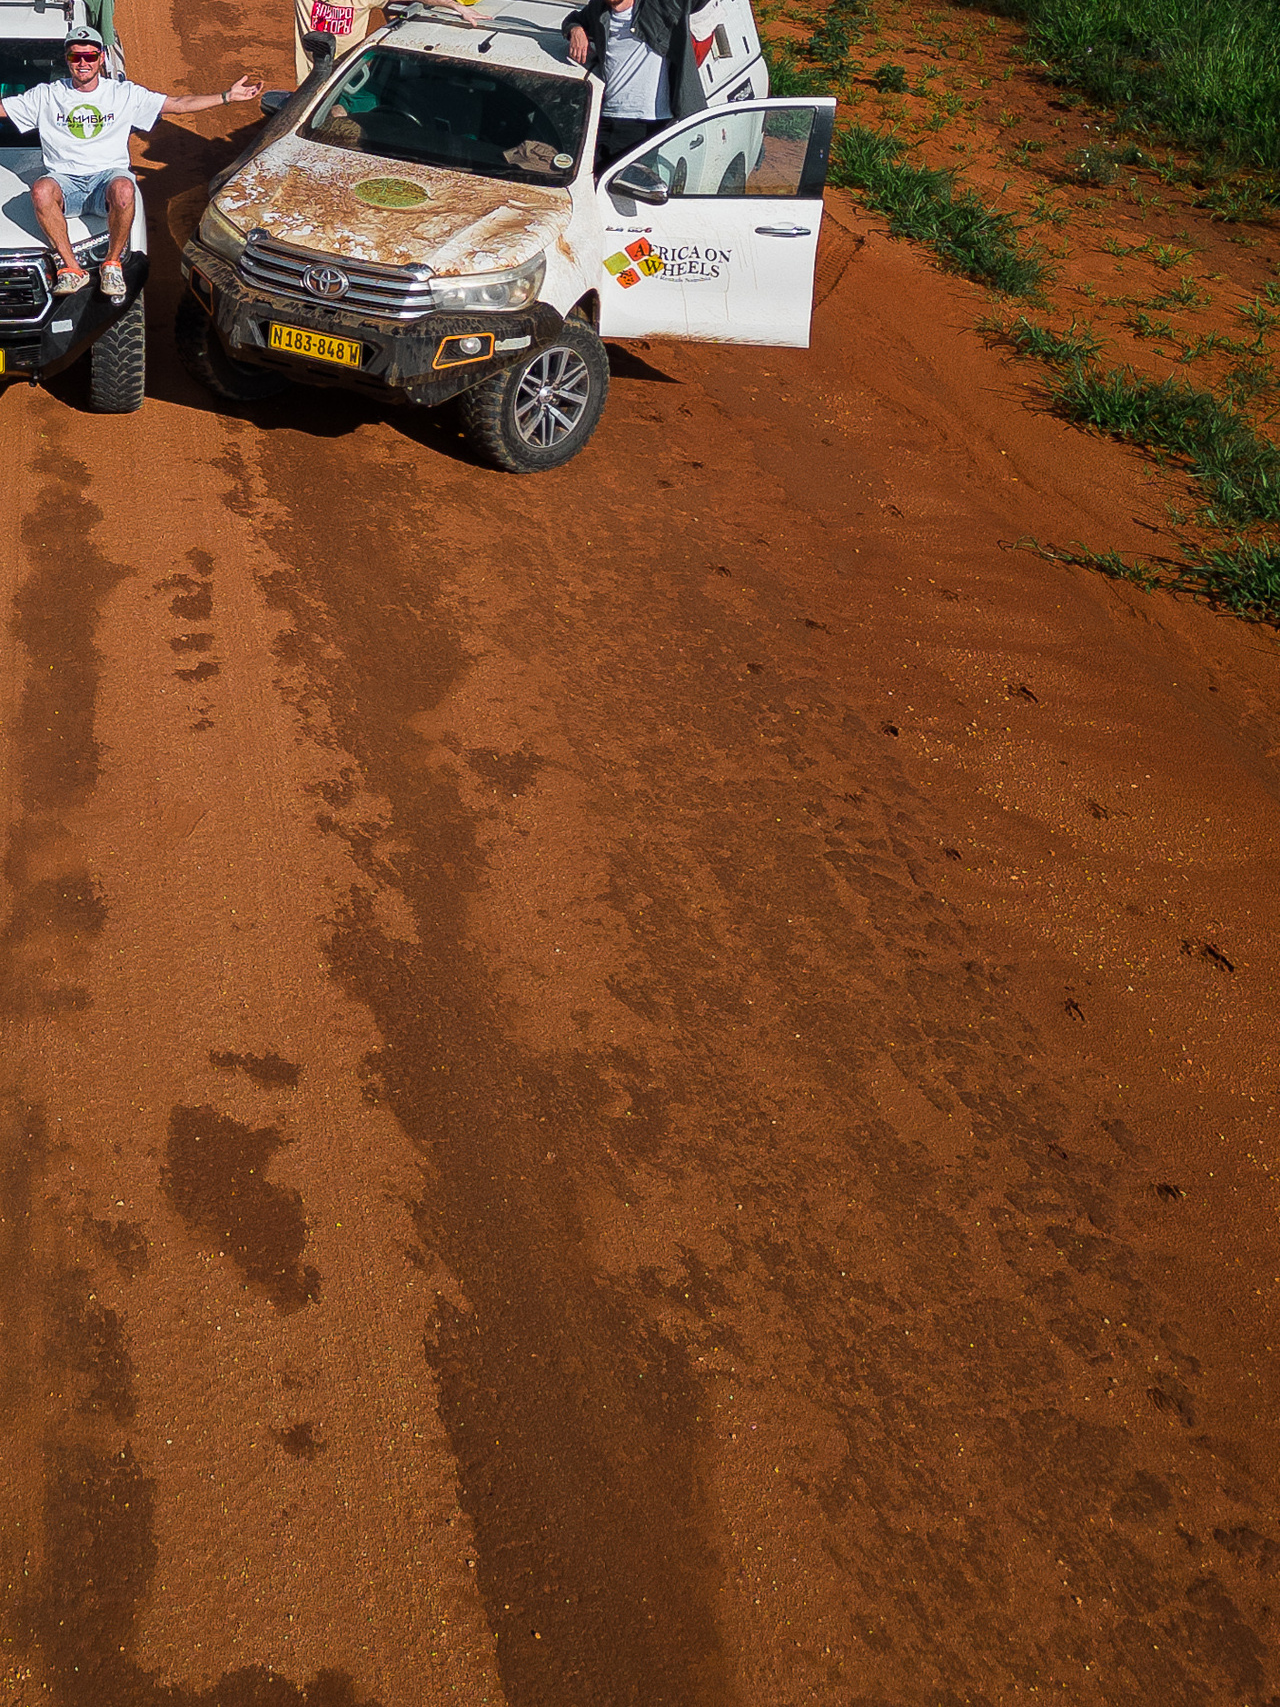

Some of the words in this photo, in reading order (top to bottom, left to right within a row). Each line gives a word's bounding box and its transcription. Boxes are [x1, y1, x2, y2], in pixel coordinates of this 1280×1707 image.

[56, 112, 115, 124] НАМИБИЯ
[634, 242, 701, 261] AFRICA
[705, 248, 733, 263] ON
[644, 258, 720, 278] WHEELS
[273, 327, 283, 346] N
[285, 330, 344, 360] 183-848
[348, 343, 358, 363] W
